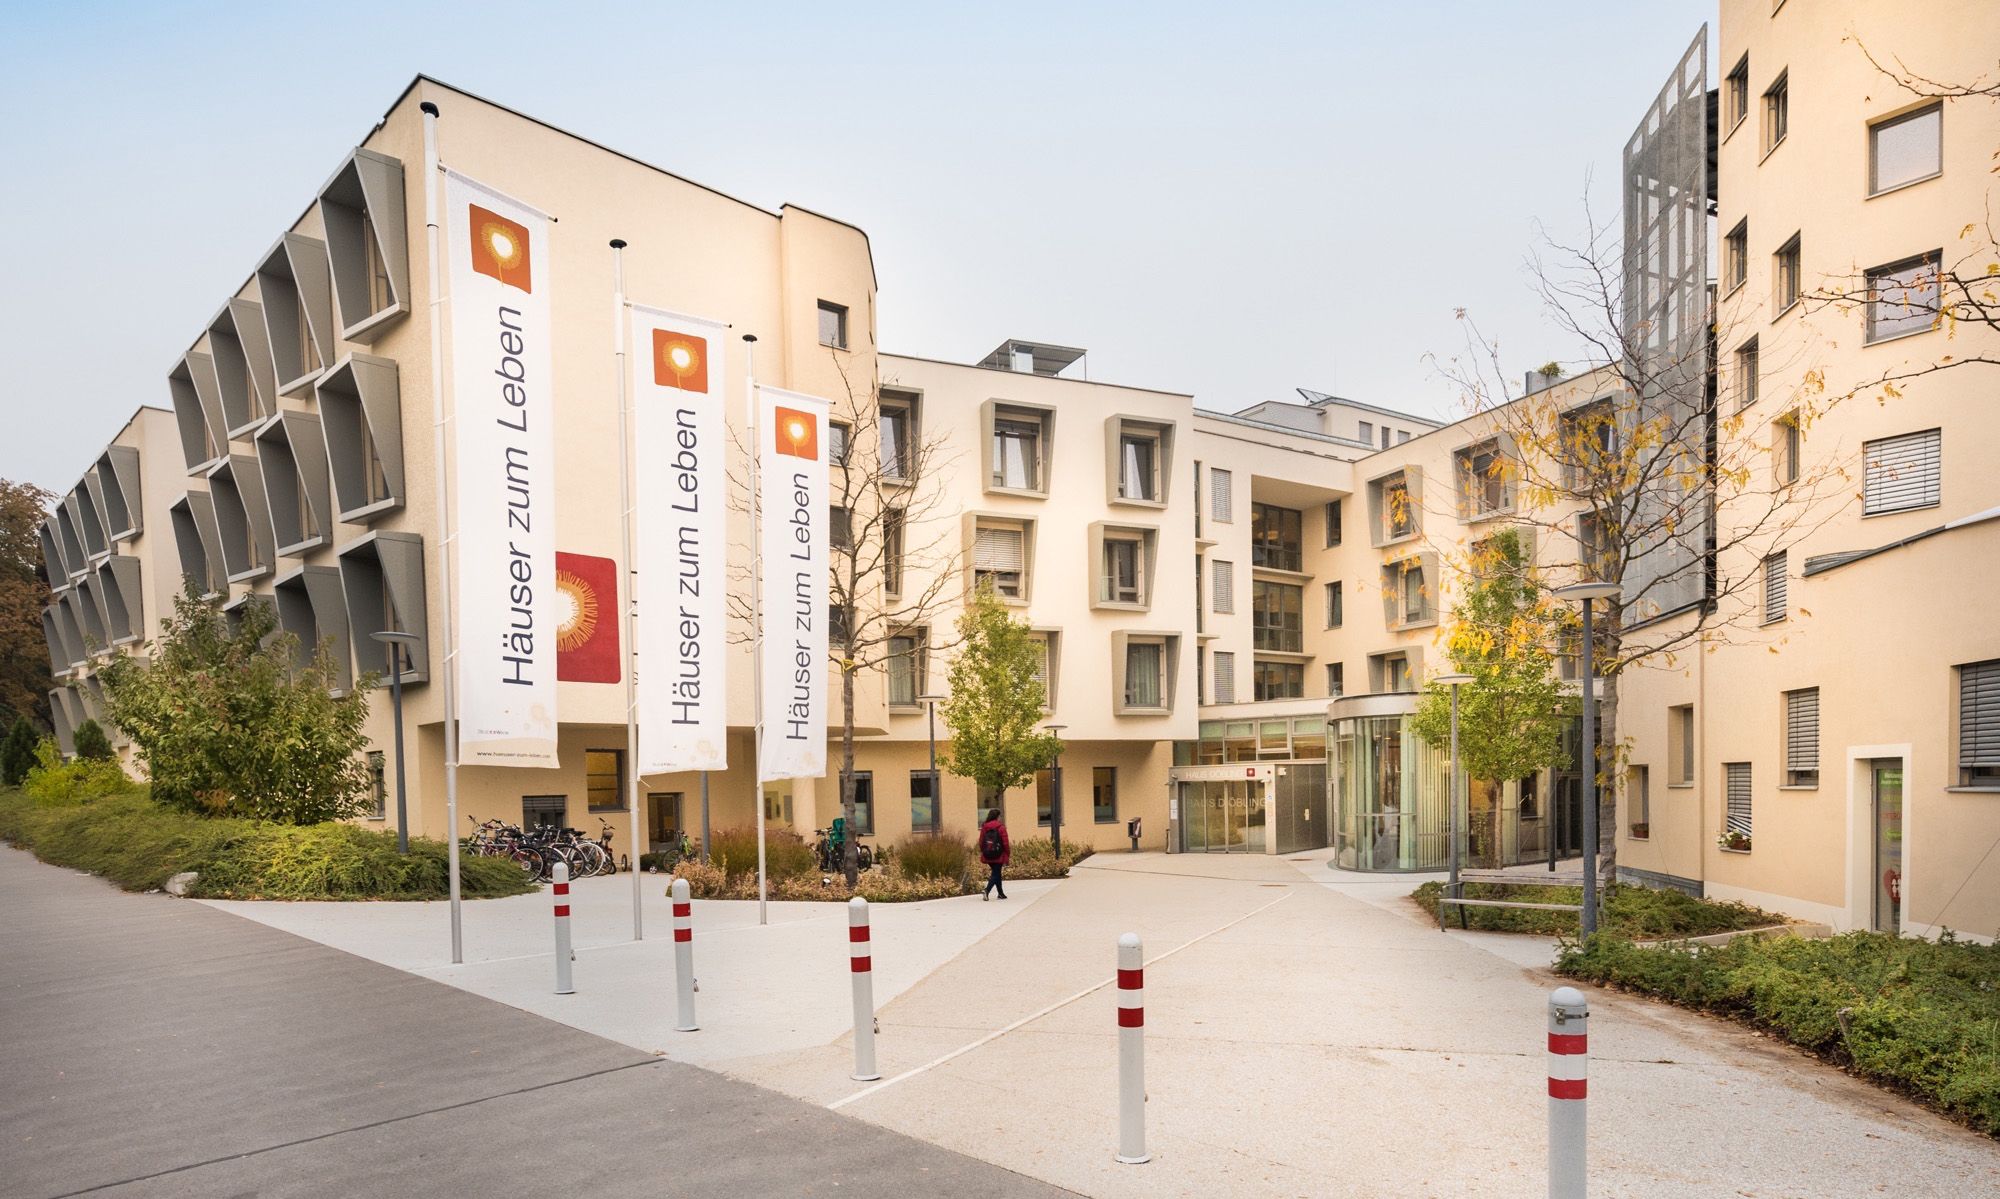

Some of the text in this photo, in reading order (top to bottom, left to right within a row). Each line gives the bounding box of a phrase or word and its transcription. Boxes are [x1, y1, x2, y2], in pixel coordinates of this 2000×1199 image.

[494, 306, 534, 686] Häuser zum Leben
[670, 408, 700, 725] Häuser zum Leben
[786, 473, 811, 740] Häuser zum Leben
